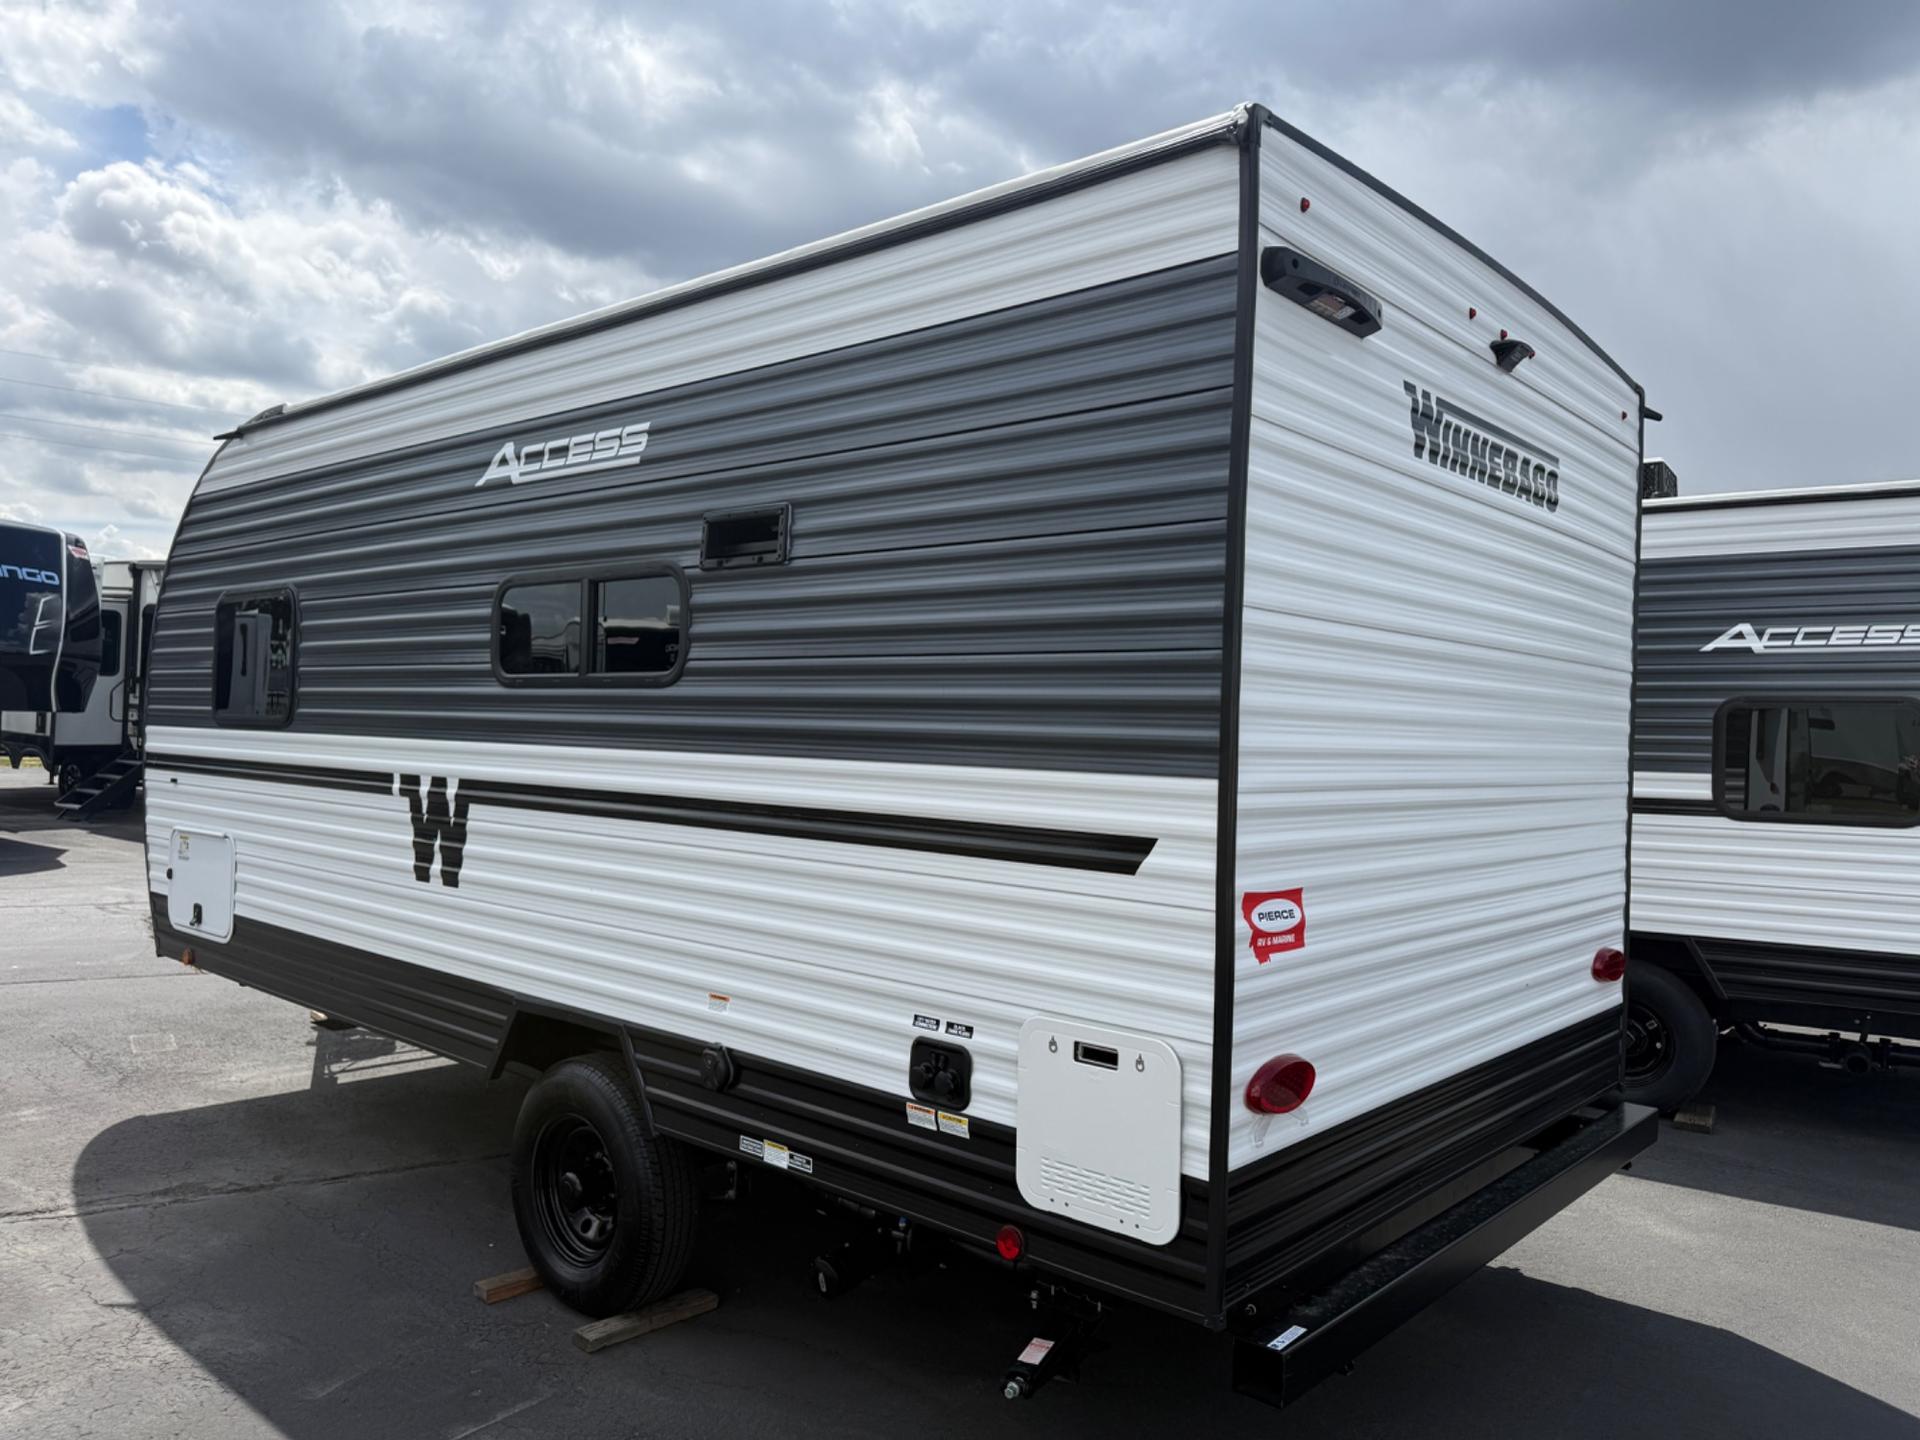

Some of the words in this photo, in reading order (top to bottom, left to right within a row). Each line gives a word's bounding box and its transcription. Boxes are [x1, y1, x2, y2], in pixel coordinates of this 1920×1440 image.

[474, 421, 651, 487] ACCESS
[1403, 379, 1559, 513] WINNEBAGO
[0, 564, 60, 585] NGO
[399, 773, 470, 888] W
[1257, 909, 1296, 922] PIERCE
